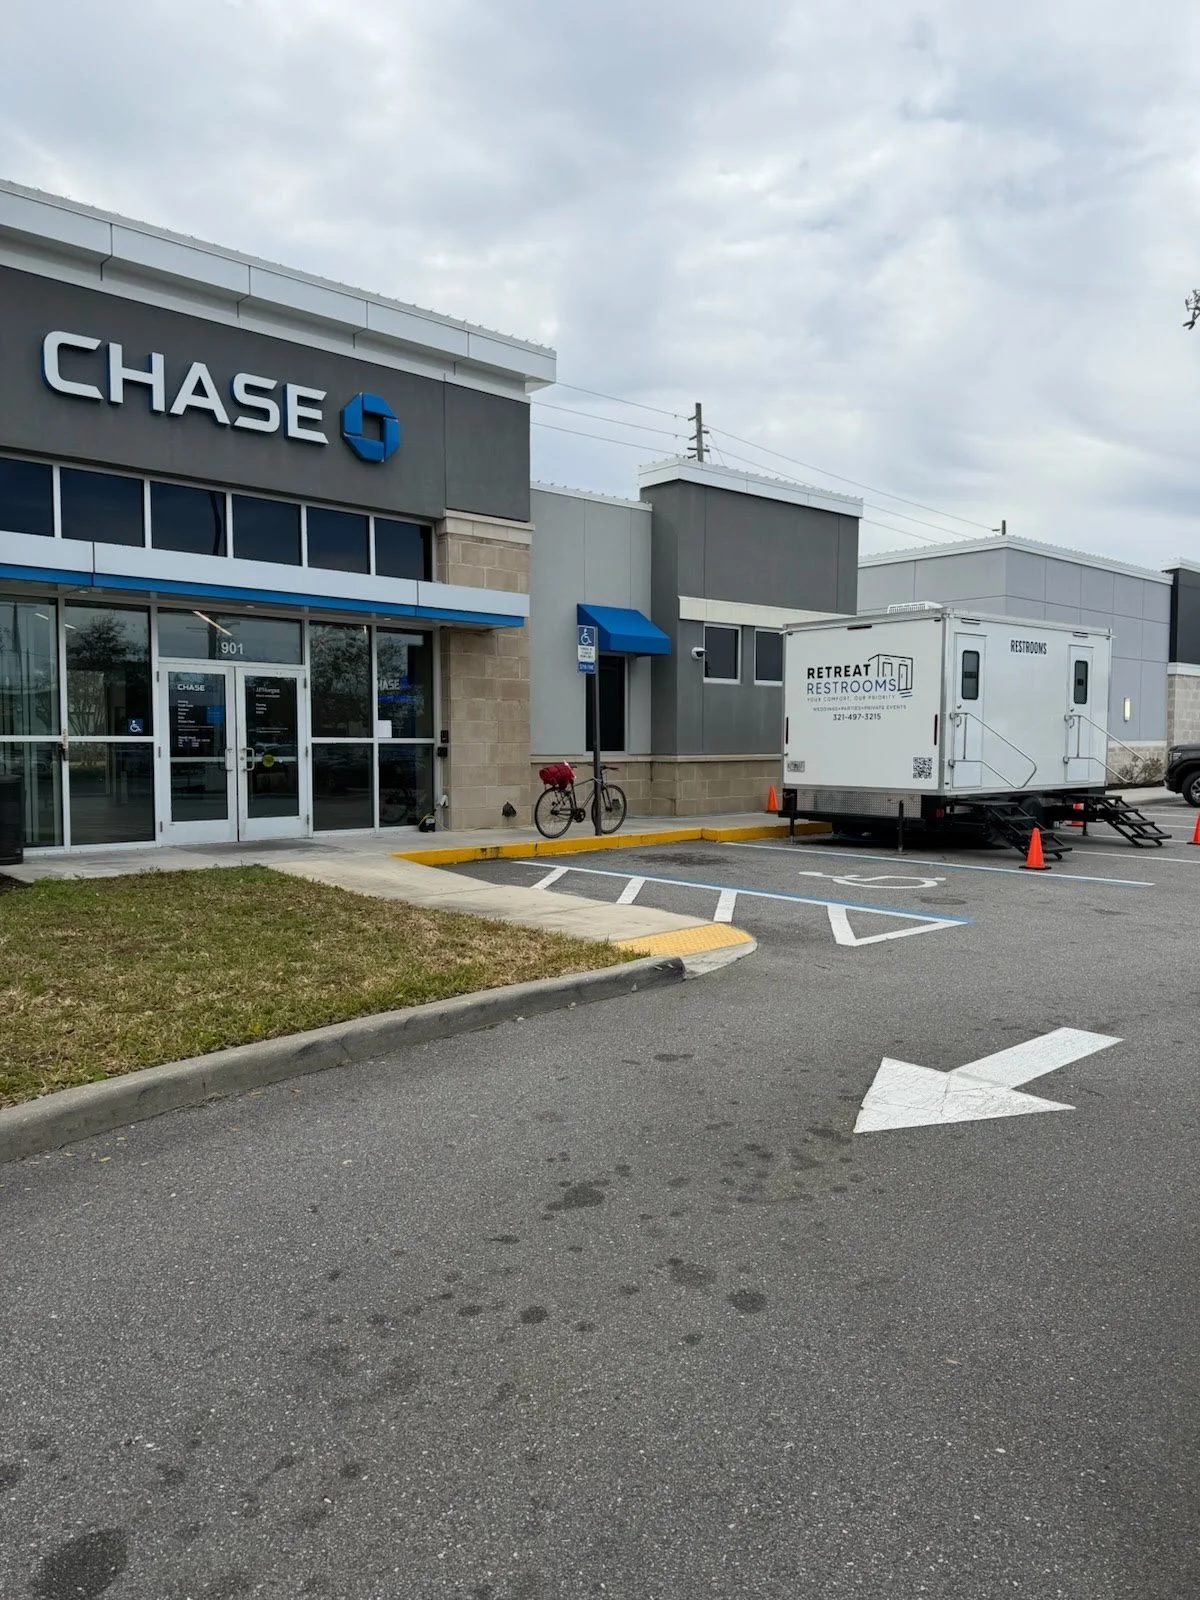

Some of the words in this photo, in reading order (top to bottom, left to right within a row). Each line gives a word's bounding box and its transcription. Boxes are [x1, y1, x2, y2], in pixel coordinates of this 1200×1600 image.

[42, 330, 329, 445] CHASE
[221, 641, 243, 654] 901
[1010, 640, 1047, 655] RESTROOMS
[807, 664, 870, 679] RETREAT
[177, 684, 205, 692] CHASE
[377, 679, 399, 690] HASE
[807, 679, 896, 694] RESTROOMS
